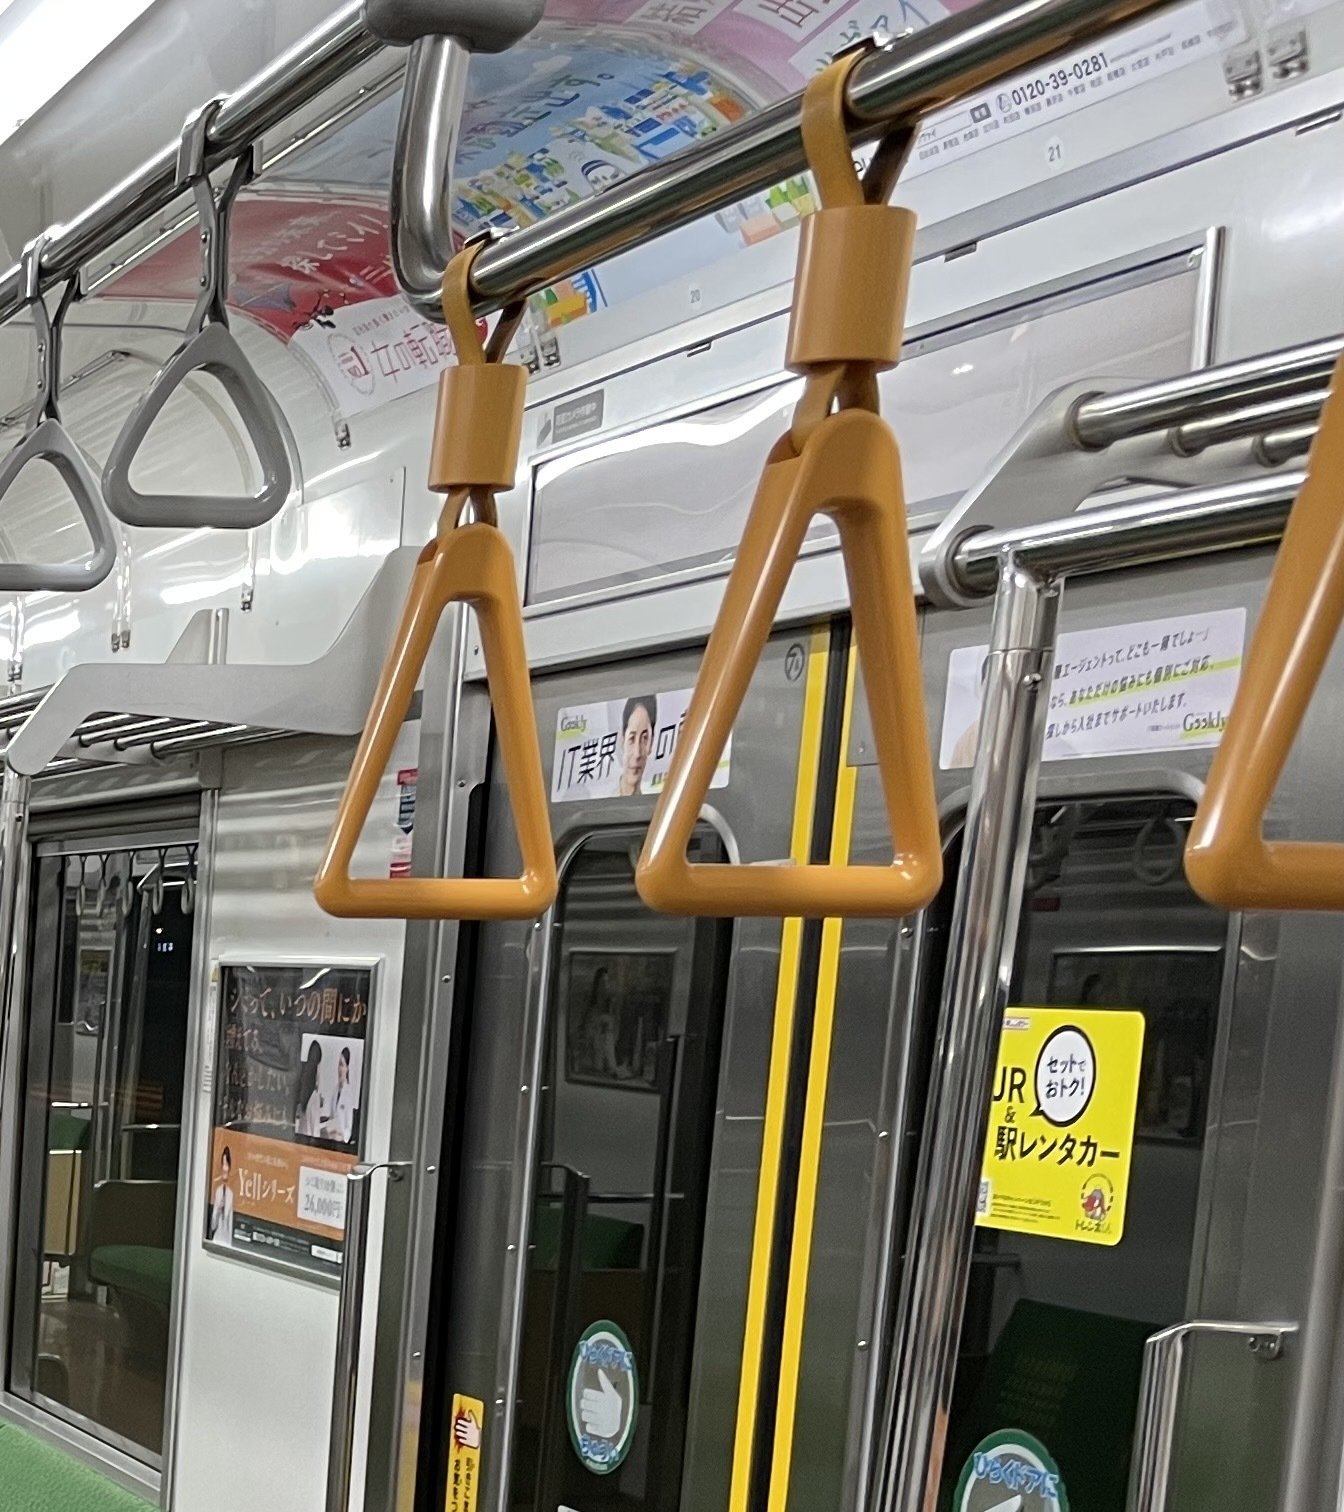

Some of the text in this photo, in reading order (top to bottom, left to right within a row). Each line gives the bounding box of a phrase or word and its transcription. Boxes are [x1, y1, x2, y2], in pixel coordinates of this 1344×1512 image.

[1011, 52, 1108, 106] 0120-39-0281
[1048, 143, 1062, 163] 21
[557, 732, 618, 792] IT業界
[1047, 1054, 1087, 1074] セットで
[993, 1066, 1027, 1104] JR
[1045, 1077, 1086, 1098] おトク!
[1004, 1106, 1016, 1123] &
[994, 1125, 1120, 1167] 駅レンタカー
[238, 1167, 297, 1204] Yellシリーズ
[974, 1451, 1059, 1500] ひらくドアに
